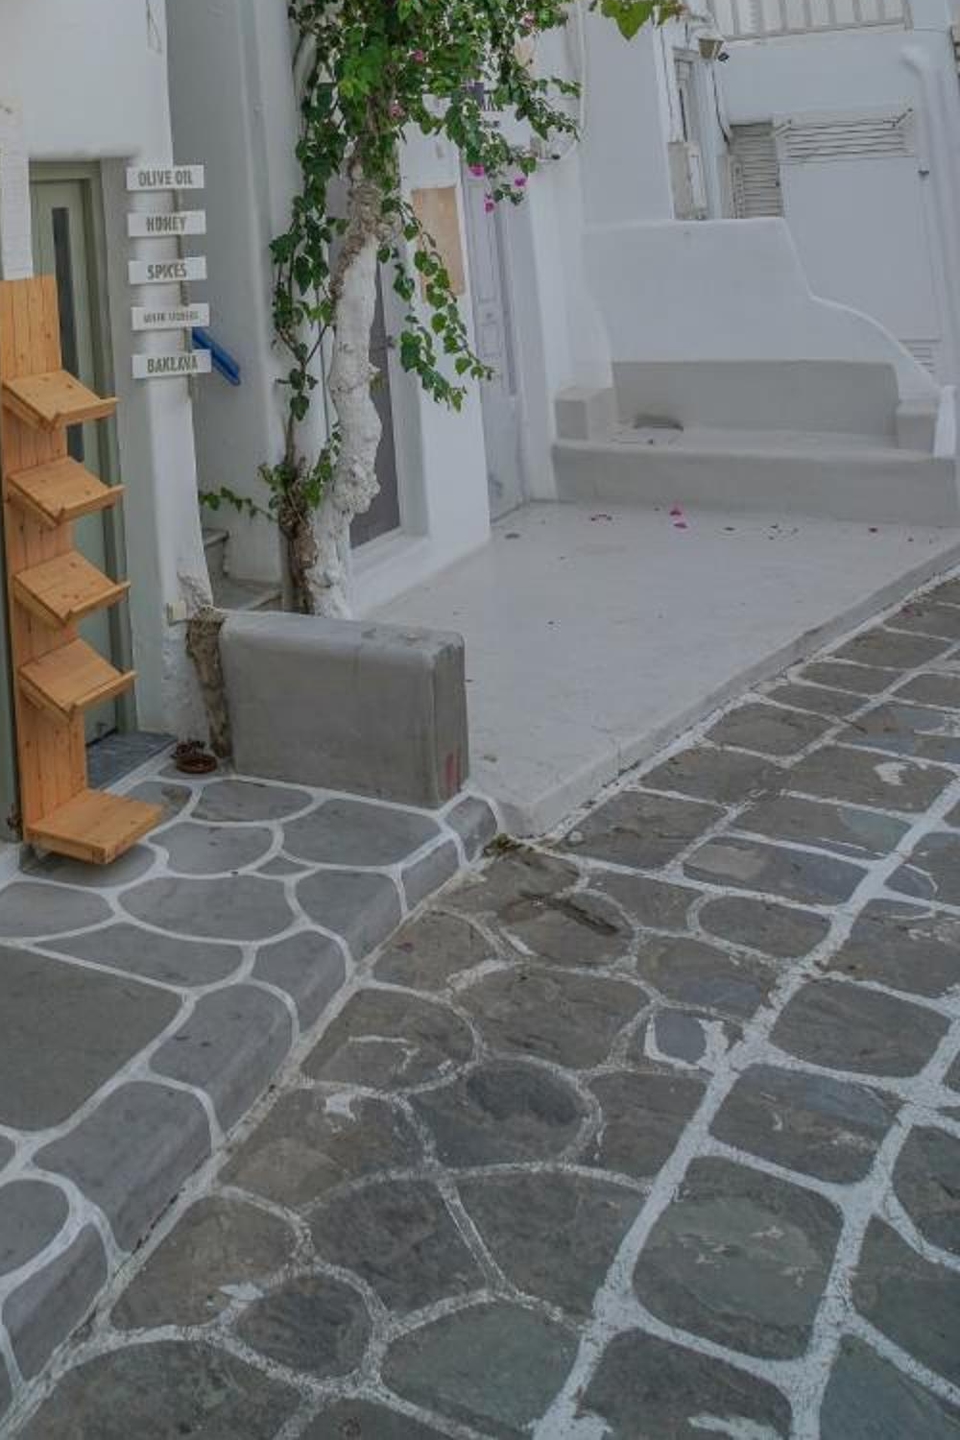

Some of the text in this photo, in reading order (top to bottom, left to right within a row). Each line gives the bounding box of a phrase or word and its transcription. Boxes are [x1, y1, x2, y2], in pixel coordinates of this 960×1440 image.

[138, 169, 193, 187] OLIVE OIL
[146, 216, 187, 232] HONEY
[146, 264, 187, 280] SPICES
[147, 354, 198, 373] BAKLAVA
